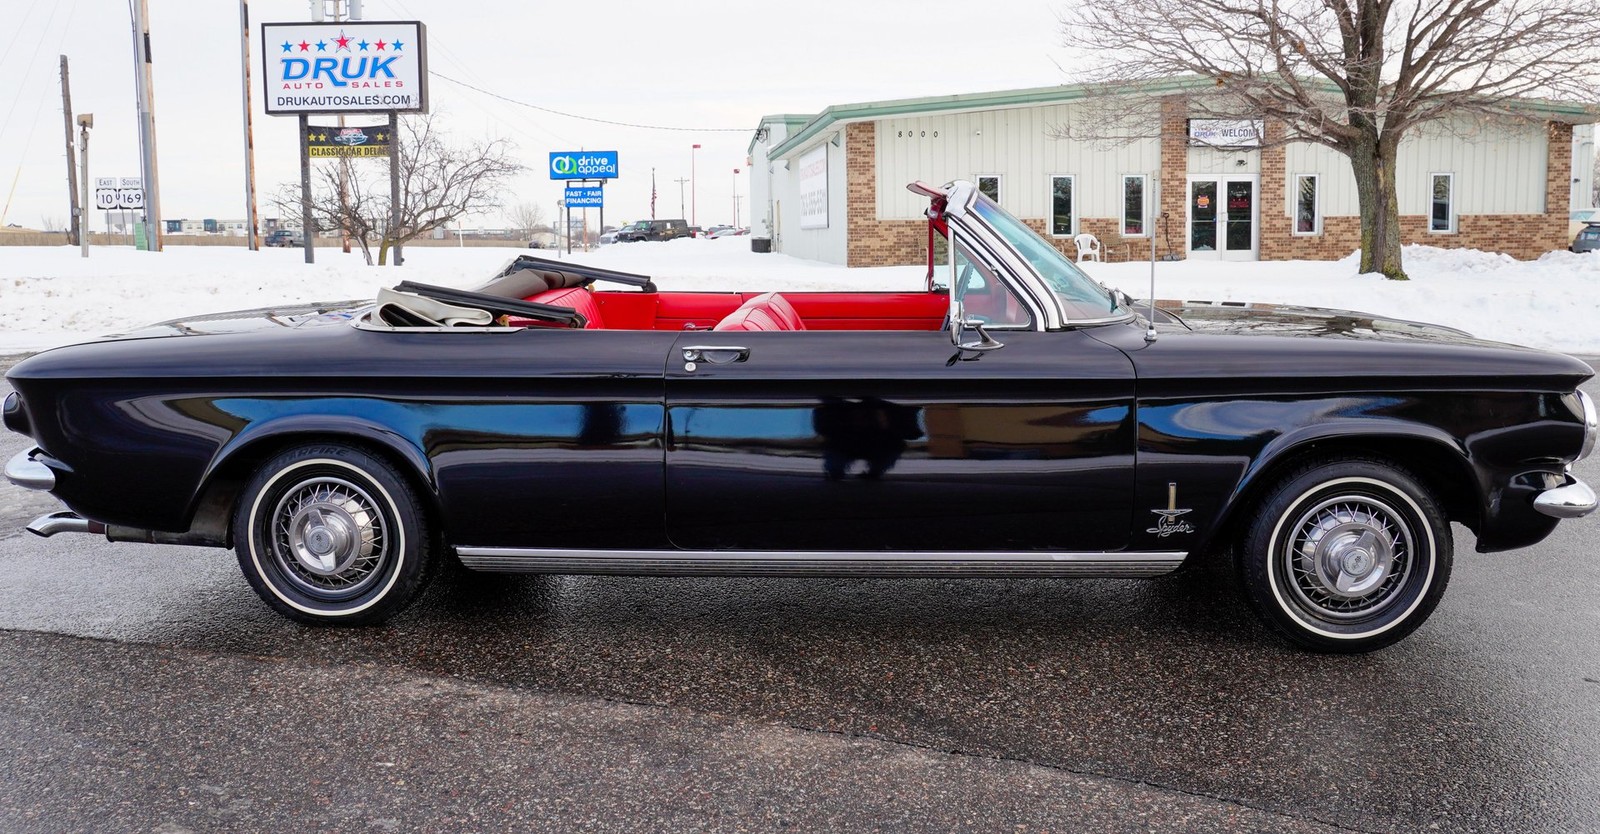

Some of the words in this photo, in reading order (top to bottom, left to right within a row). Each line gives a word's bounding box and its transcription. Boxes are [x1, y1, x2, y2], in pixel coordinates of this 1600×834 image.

[281, 56, 401, 87] DRUK
[283, 82, 324, 90] AUTO
[278, 95, 411, 106] DRUKAUTOSALES.COM
[311, 147, 345, 157] CLASSIC
[346, 147, 362, 156] CAR
[577, 155, 608, 166] drive
[577, 164, 616, 175] appeal
[99, 178, 112, 186] EAST
[122, 178, 140, 186] SOUTH
[101, 194, 113, 204] 10
[122, 193, 141, 204] 169
[1146, 515, 1194, 538] Spyder
